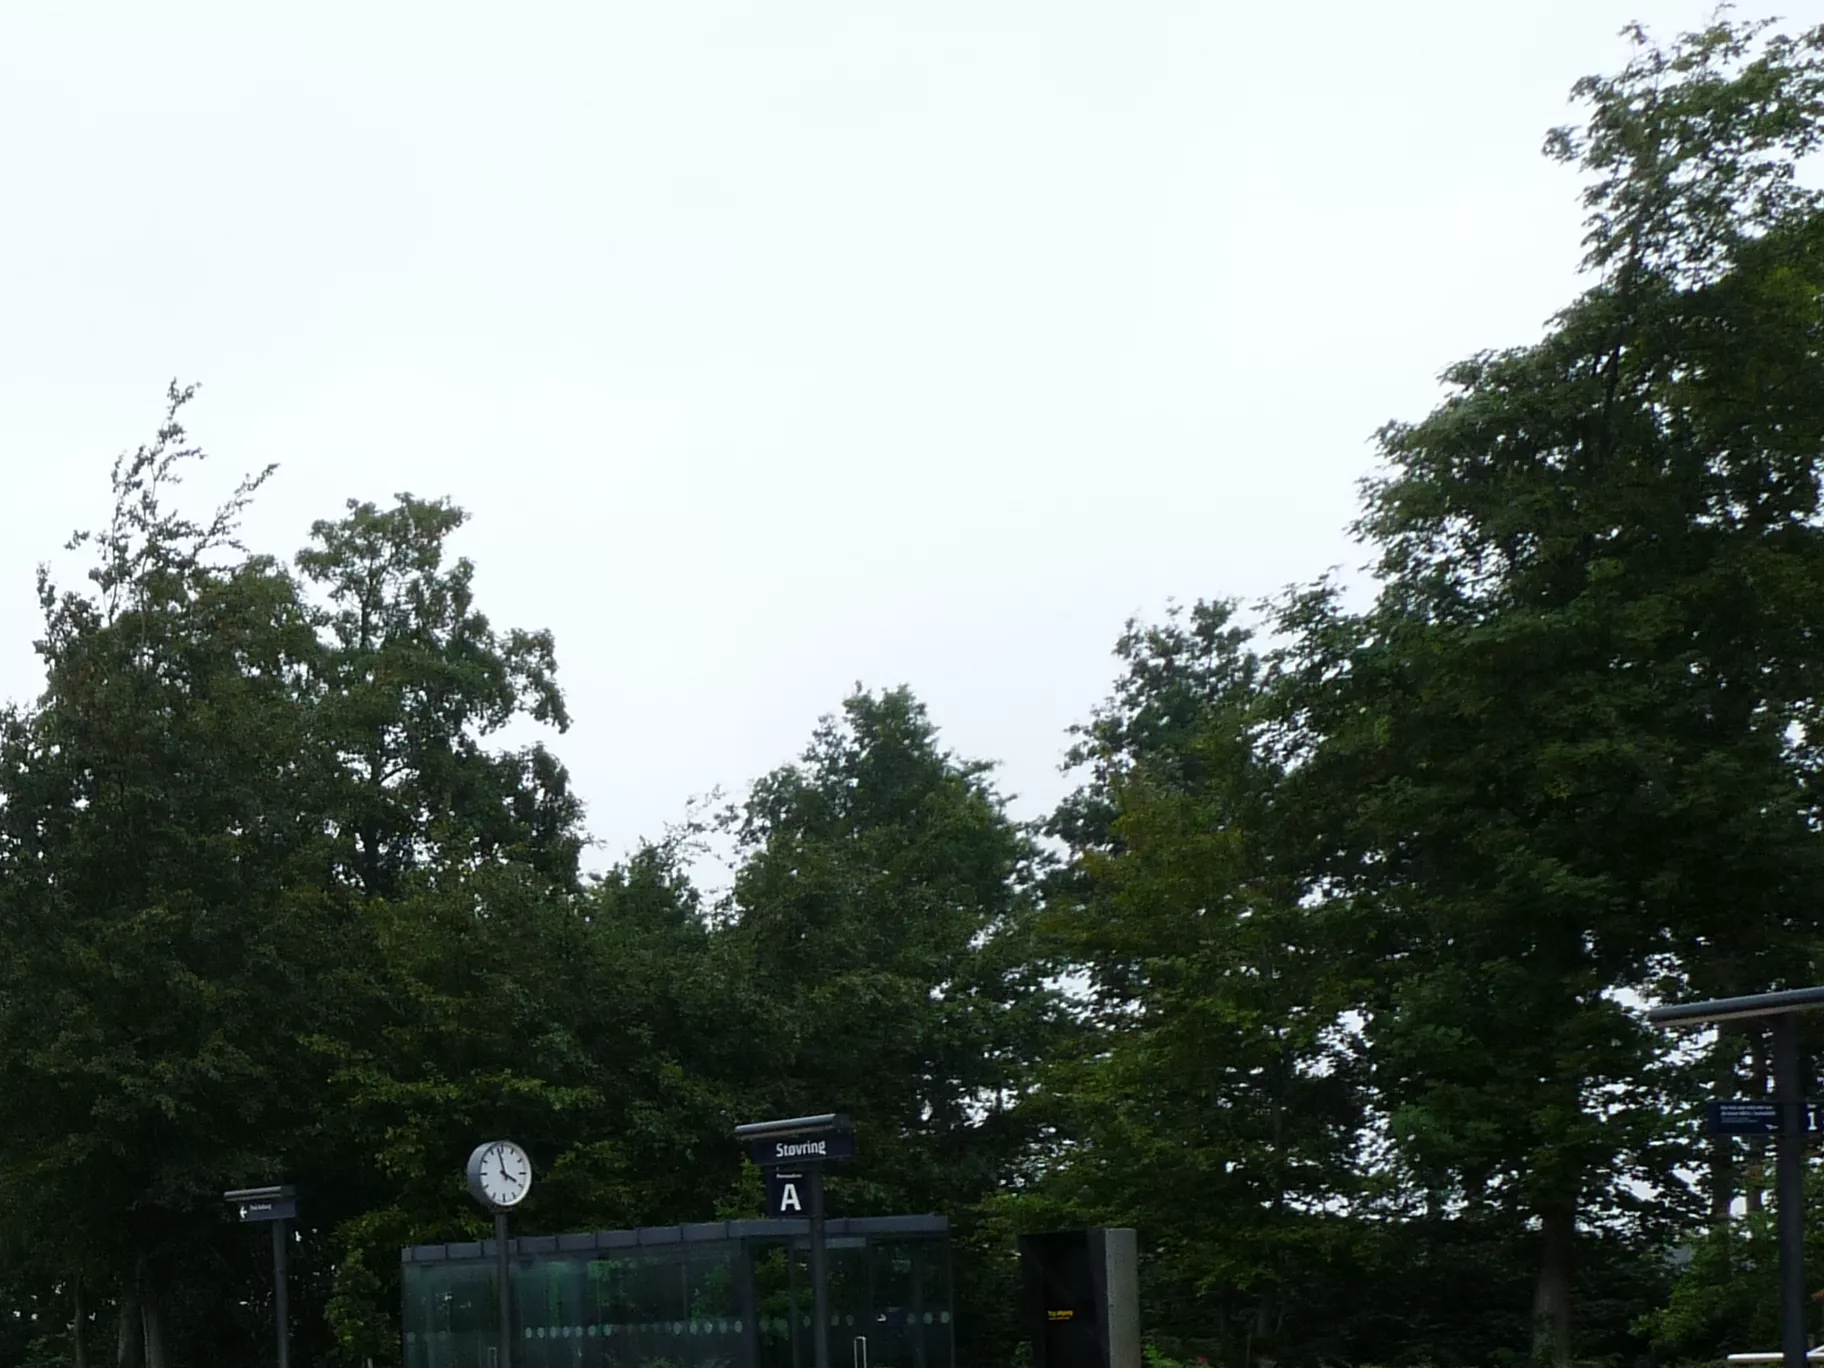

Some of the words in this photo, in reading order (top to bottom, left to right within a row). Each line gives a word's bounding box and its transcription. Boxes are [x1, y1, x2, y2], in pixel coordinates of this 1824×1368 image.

[1807, 1111, 1819, 1131] 1
[776, 1140, 826, 1157] Støvring
[780, 1183, 802, 1212] A
